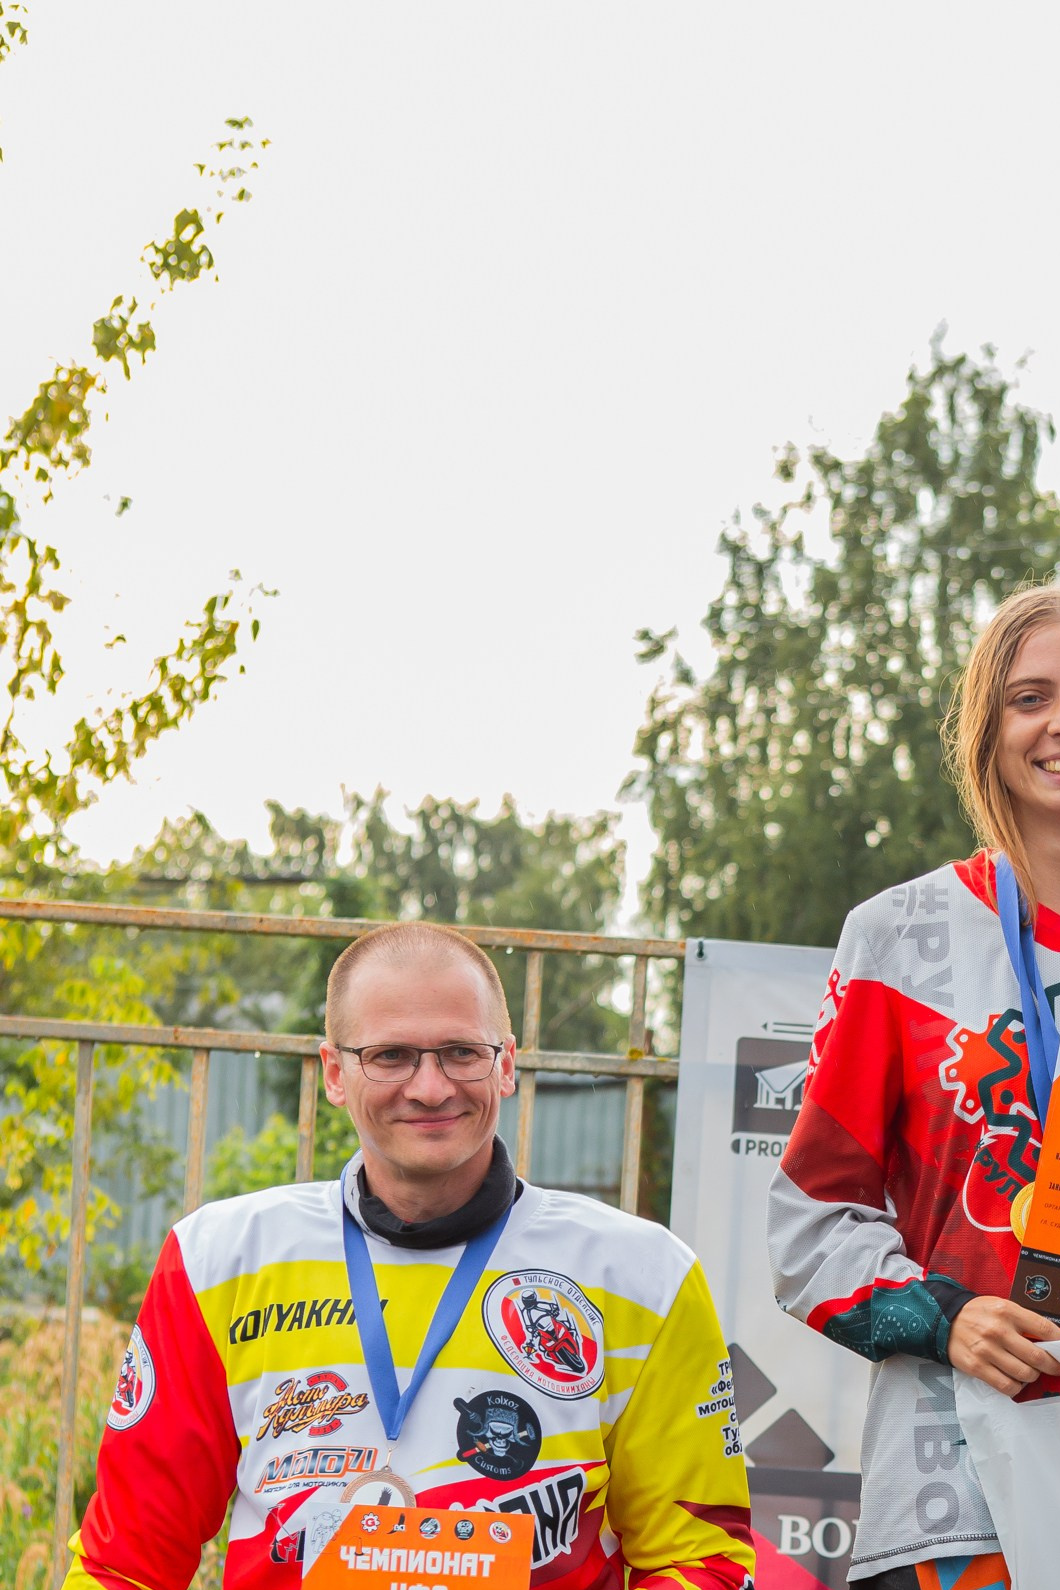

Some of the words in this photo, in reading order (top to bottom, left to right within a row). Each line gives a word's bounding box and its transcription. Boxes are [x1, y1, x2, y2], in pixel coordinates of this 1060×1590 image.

[745, 1138, 786, 1158] PRO
[523, 1275, 564, 1289] ТУЛЬСКОЕ
[566, 1285, 599, 1327] ОТДЕЛЕНИЕ
[499, 1335, 535, 1379] ФЕДЕРАЦИЯ
[487, 1396, 520, 1411] Kolxoz
[474, 1456, 512, 1476] Customs
[340, 1545, 496, 1578] ЧЕМПИОНАТ
